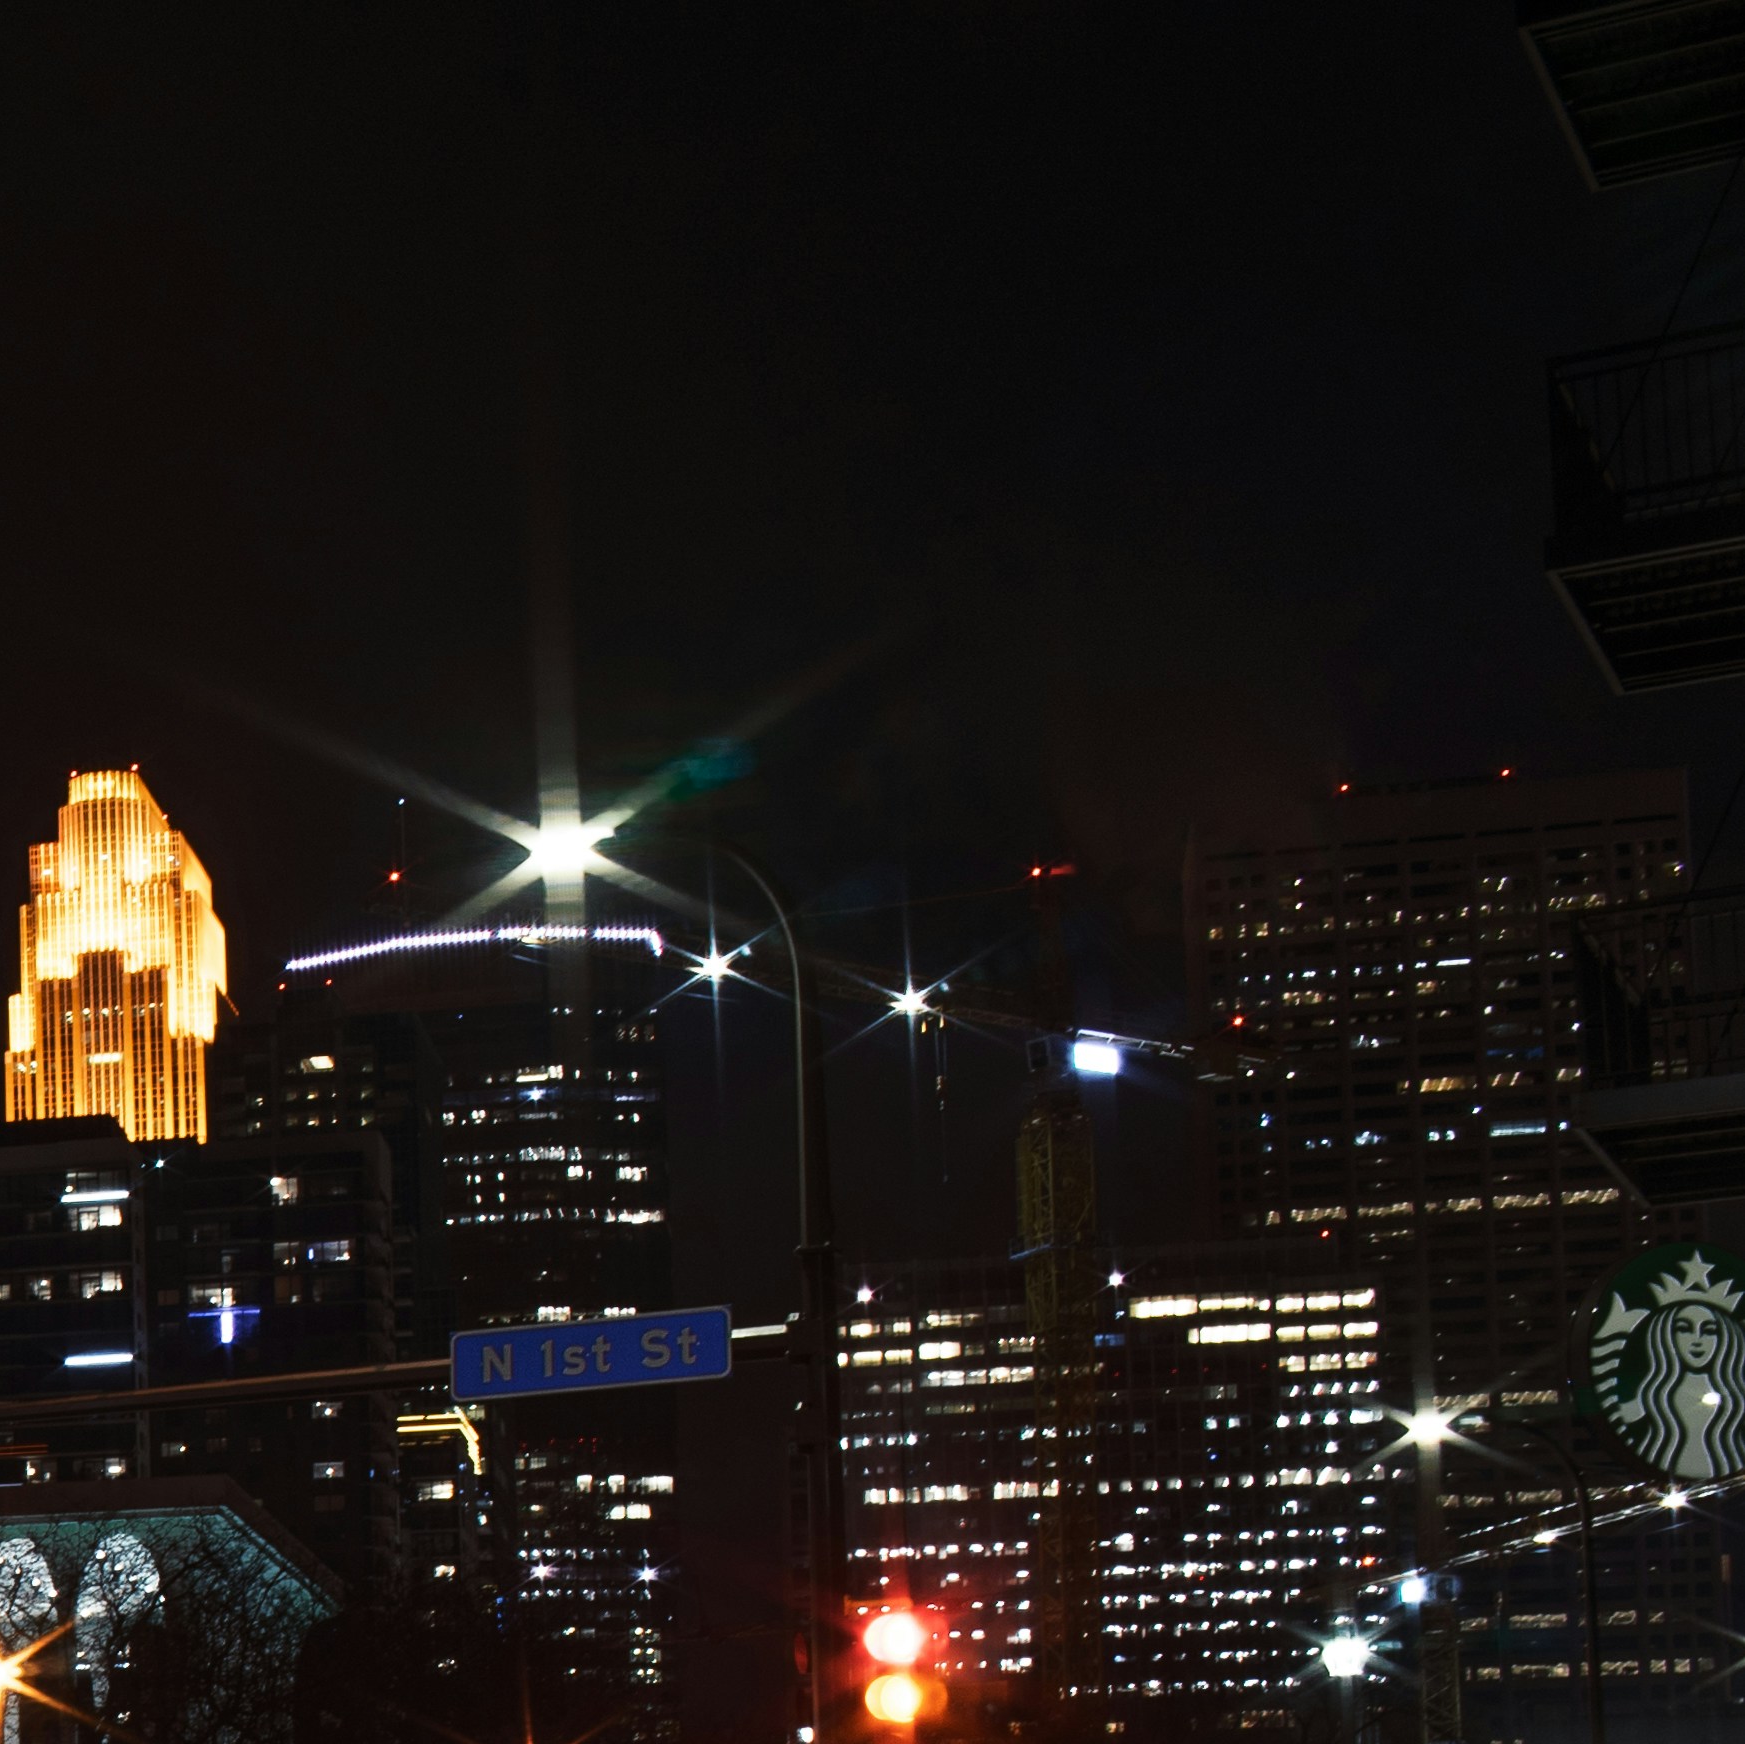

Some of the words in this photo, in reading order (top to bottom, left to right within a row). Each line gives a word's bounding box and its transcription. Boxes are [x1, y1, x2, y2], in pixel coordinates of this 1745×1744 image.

[482, 1343, 512, 1383] N
[541, 1334, 611, 1378] 1st
[640, 1326, 698, 1368] St
